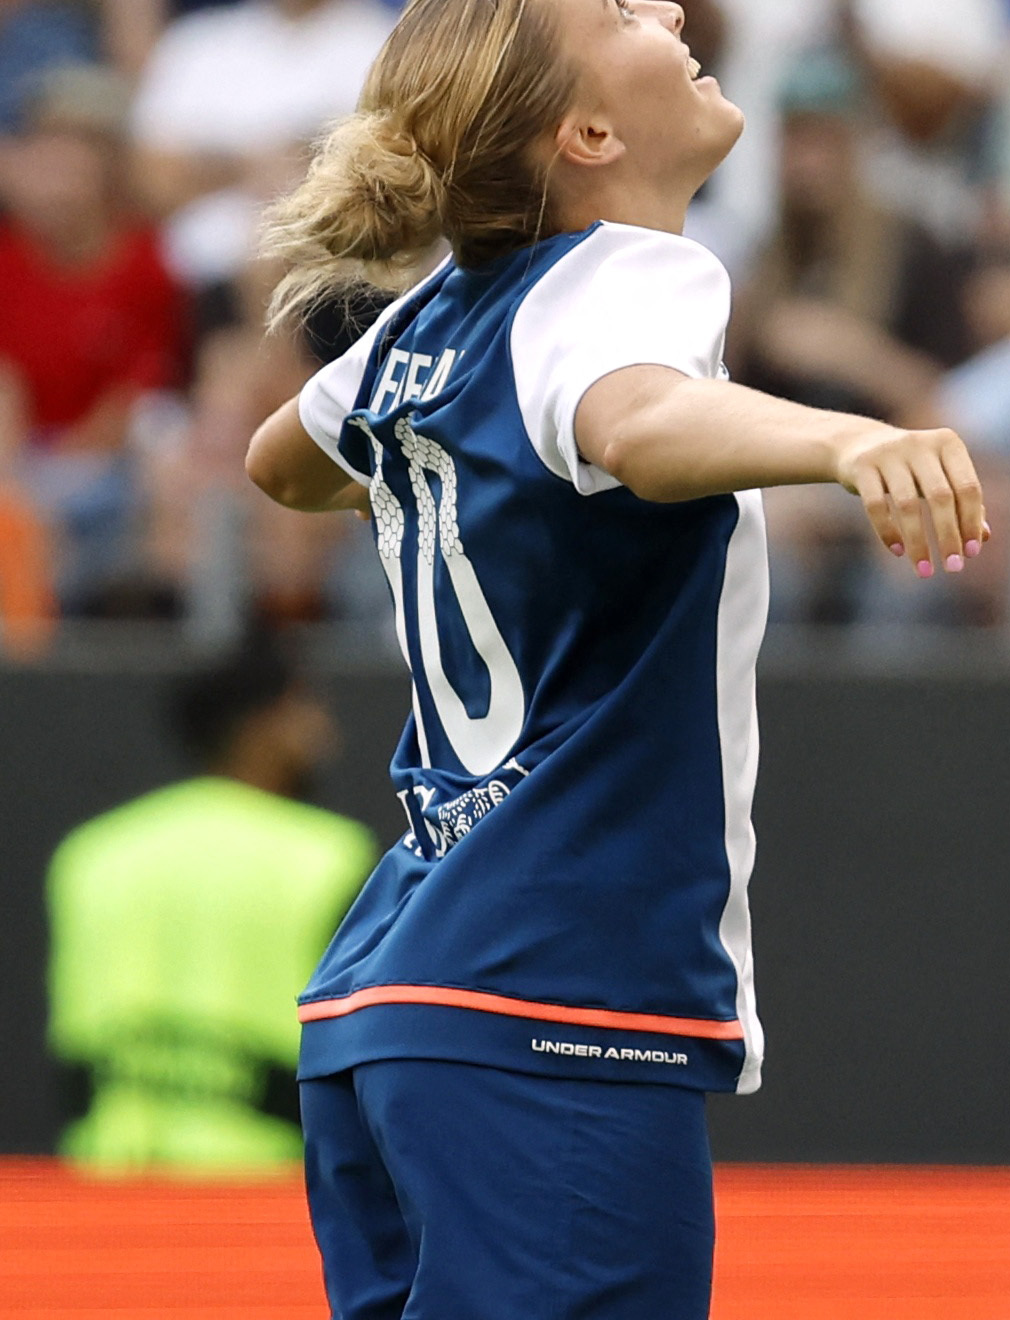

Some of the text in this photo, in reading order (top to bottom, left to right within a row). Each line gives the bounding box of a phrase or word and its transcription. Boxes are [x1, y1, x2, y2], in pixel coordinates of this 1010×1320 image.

[347, 411, 525, 777] 10
[531, 1038, 688, 1065] UNDER ARMOUR
